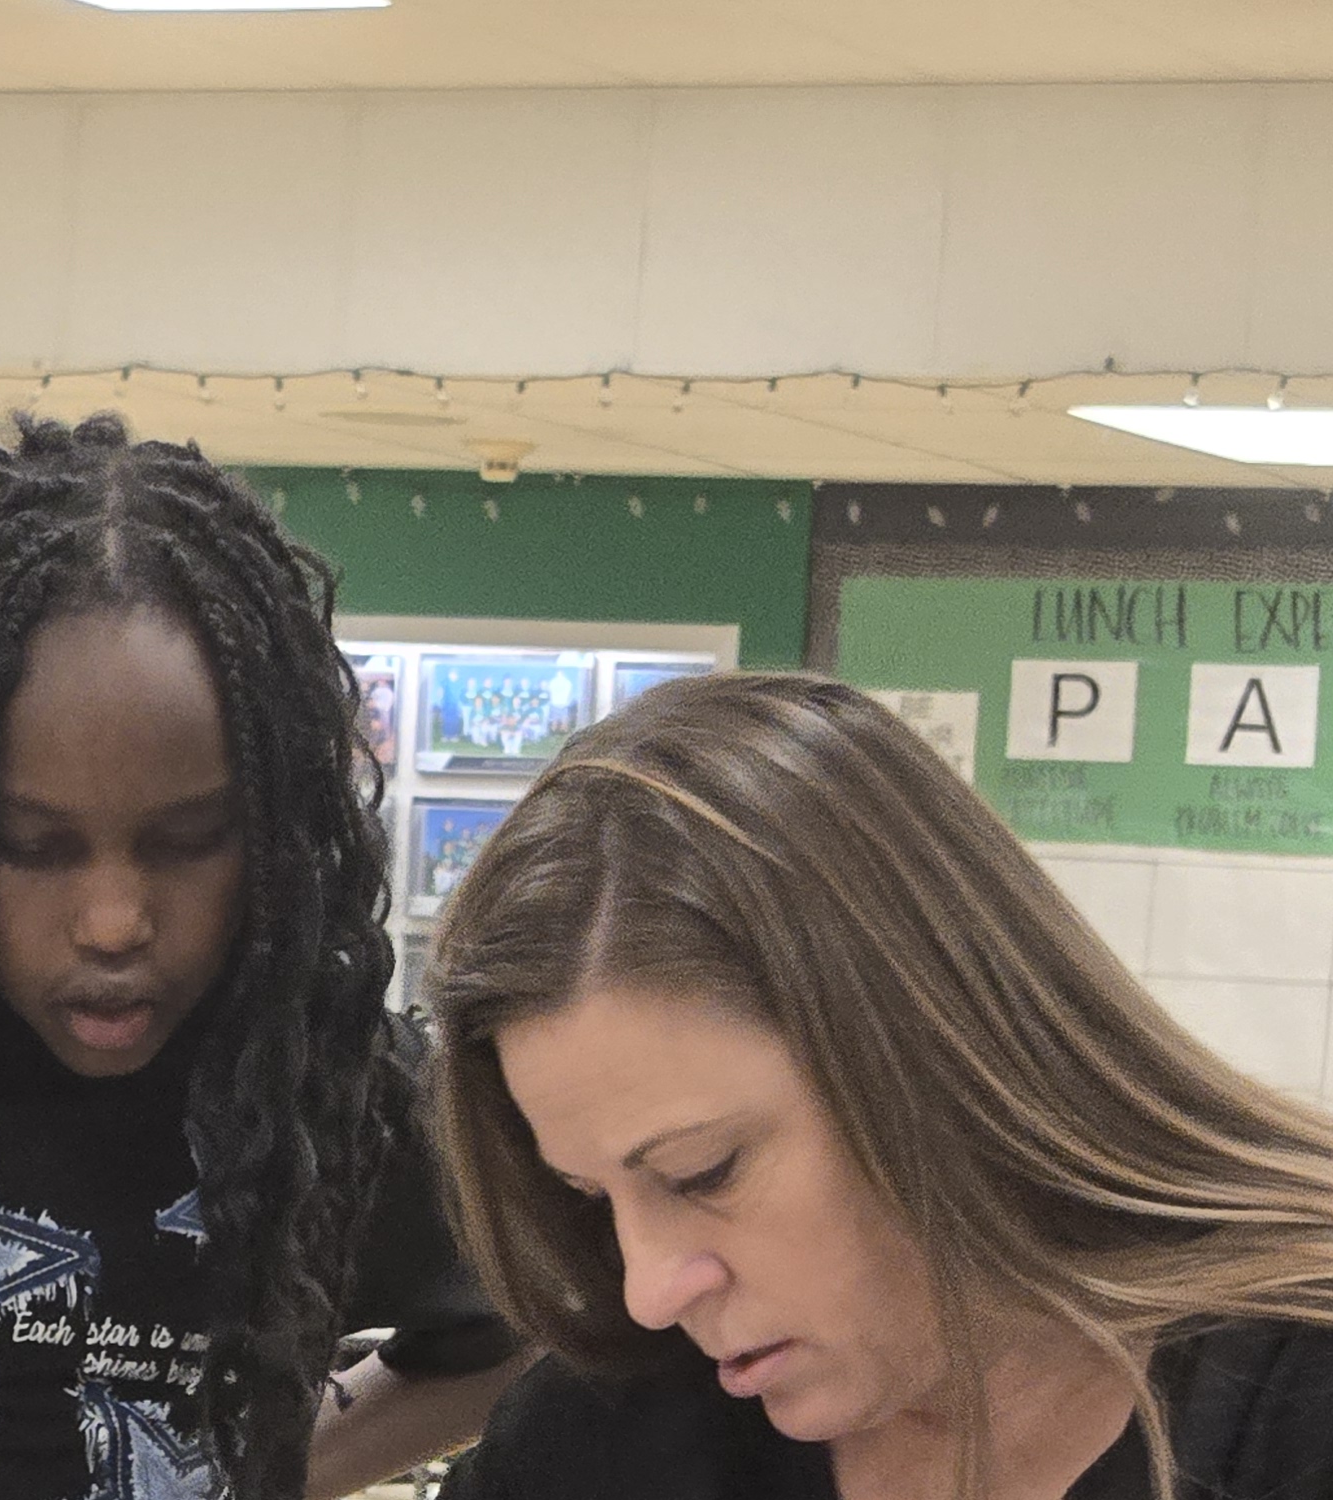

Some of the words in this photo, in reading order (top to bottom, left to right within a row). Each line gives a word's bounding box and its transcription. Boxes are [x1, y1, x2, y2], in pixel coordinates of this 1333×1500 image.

[1032, 584, 1189, 649] LUNCH
[1046, 672, 1101, 748] P
[1218, 677, 1284, 754] A
[12, 1311, 76, 1347] Each
[85, 1316, 140, 1347] star
[149, 1323, 175, 1349] is
[82, 1349, 162, 1382] shines
